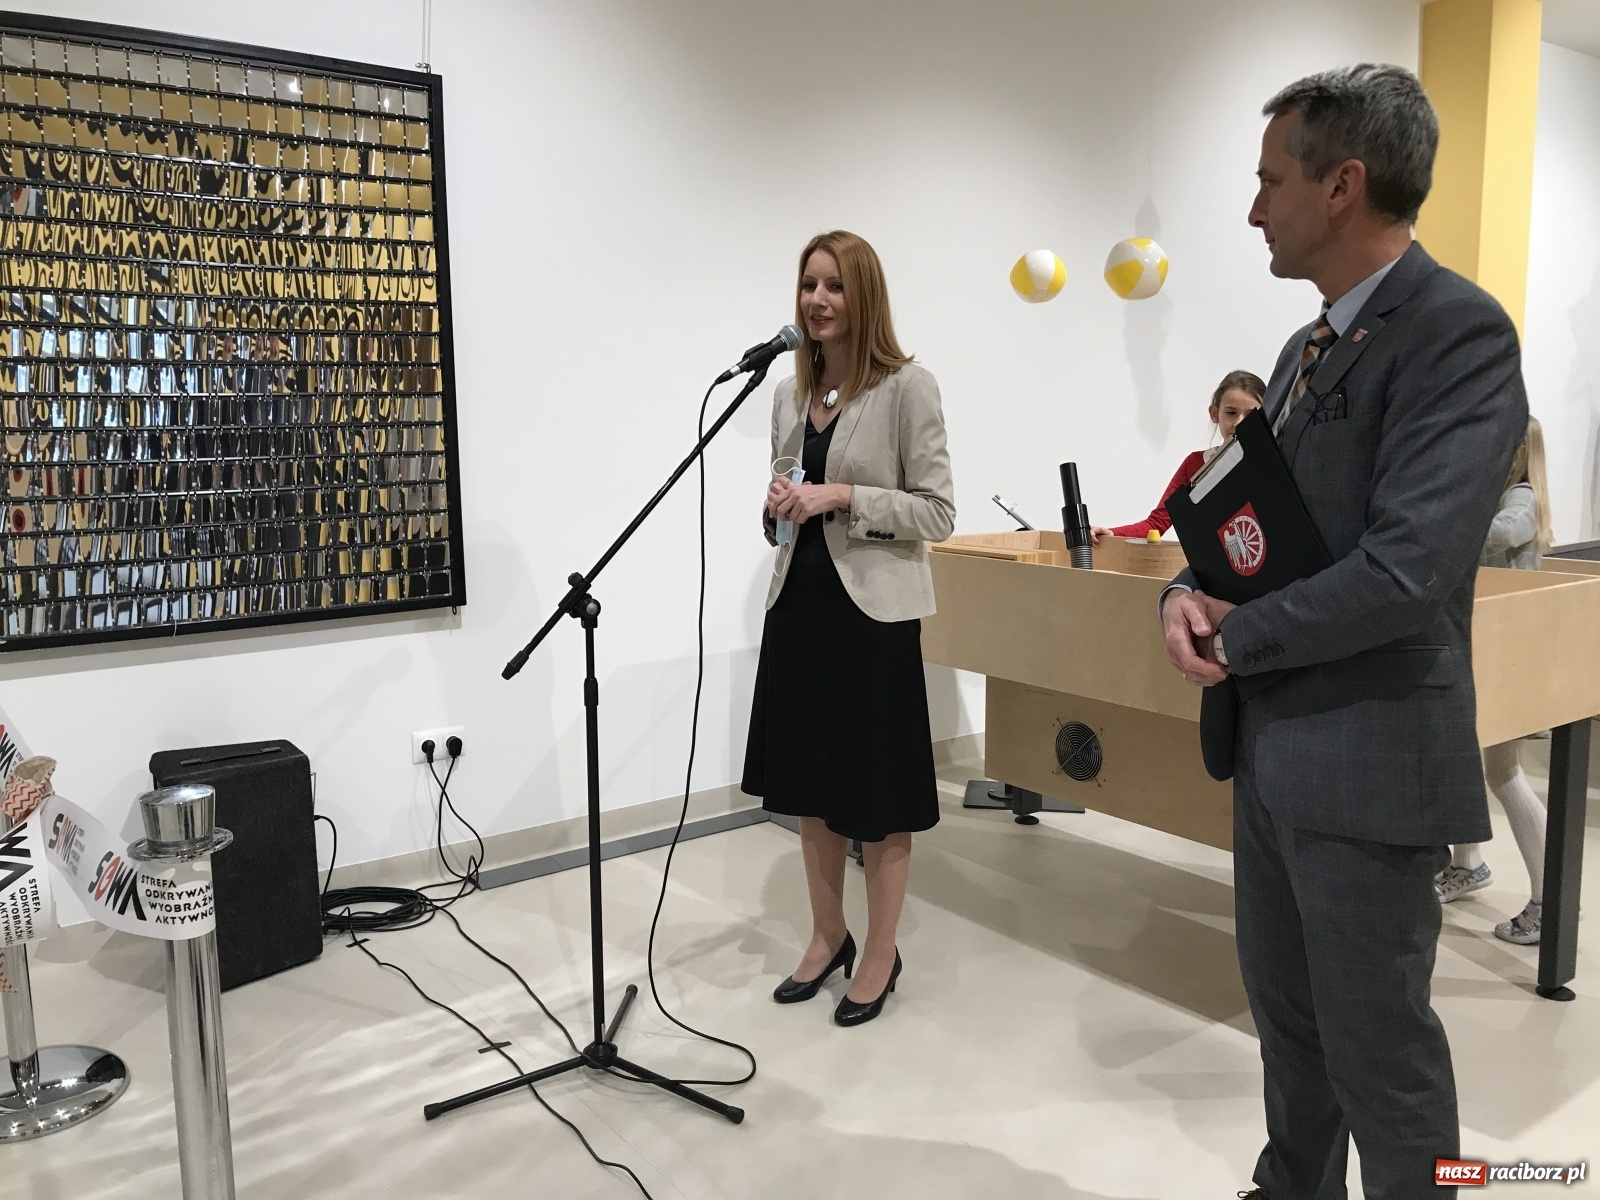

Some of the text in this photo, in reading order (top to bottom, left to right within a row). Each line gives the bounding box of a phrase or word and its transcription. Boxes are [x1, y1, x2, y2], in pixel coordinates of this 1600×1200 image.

[28, 878, 41, 914] STREFA
[87, 850, 147, 921] SOWA
[141, 874, 177, 889] STREFA
